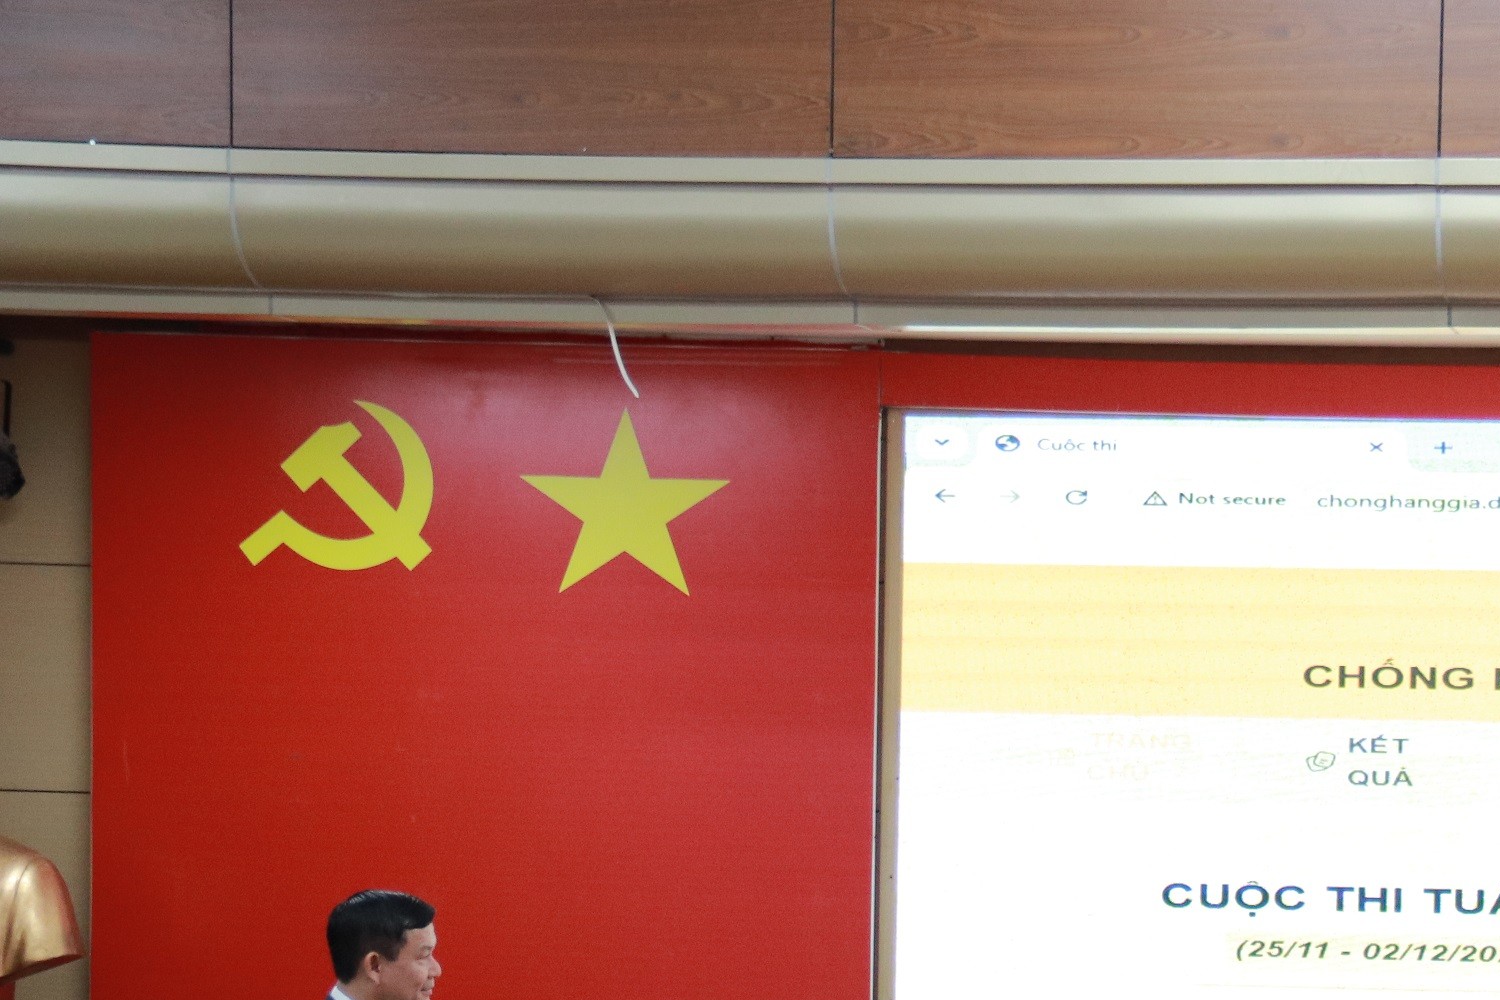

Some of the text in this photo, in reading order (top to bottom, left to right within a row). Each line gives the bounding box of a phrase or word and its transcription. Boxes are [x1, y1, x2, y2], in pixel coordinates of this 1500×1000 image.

[1036, 437, 1117, 452] Cuộc thi
[1178, 492, 1287, 506] Not secure
[1303, 657, 1474, 691] CHỐNG
[1348, 734, 1409, 754] KẾT
[1347, 766, 1413, 787] QUẢ
[1161, 880, 1305, 918] CUỘC
[1326, 886, 1402, 913] THI
[1236, 939, 1329, 962] (25/11
